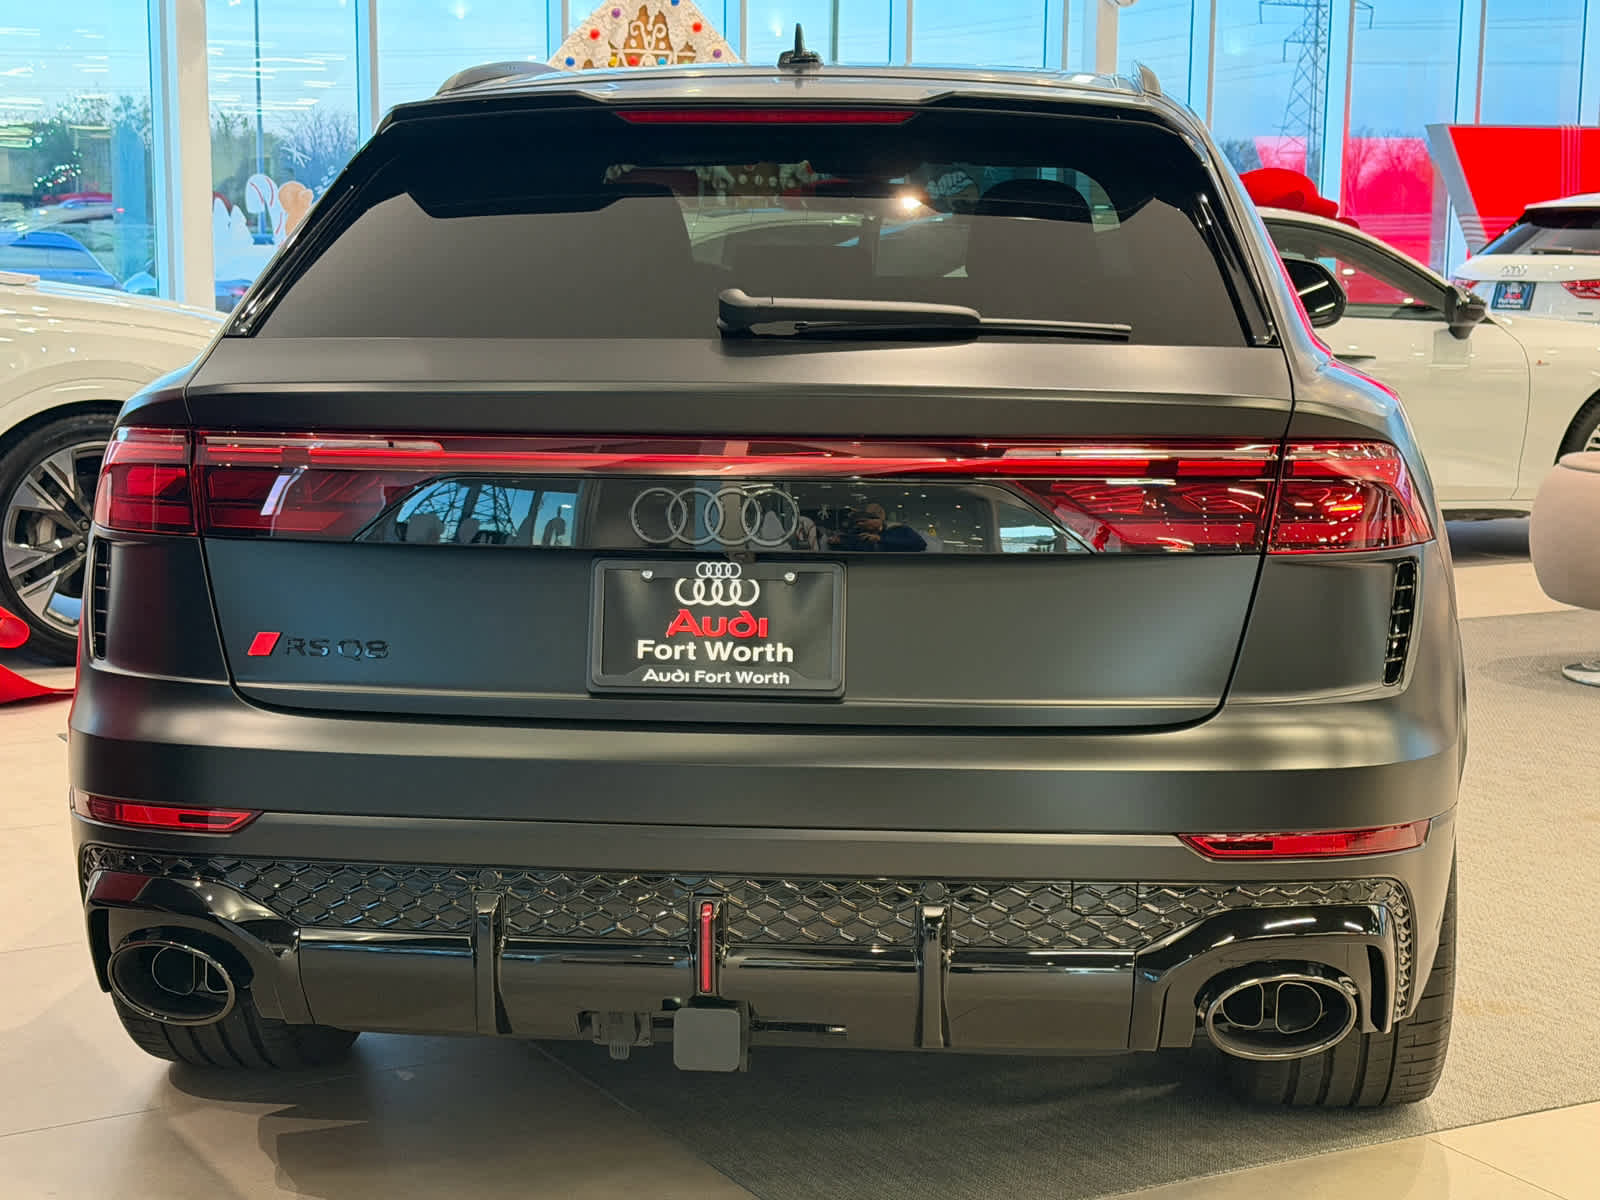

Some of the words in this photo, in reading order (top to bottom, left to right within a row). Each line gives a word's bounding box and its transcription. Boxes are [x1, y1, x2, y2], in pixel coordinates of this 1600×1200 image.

[665, 608, 769, 638] Audi
[286, 638, 330, 657] RS
[336, 639, 389, 661] Q8
[636, 640, 697, 661] Fort
[704, 641, 794, 663] Worth
[642, 669, 690, 683] Audi
[695, 670, 731, 684] Fort
[736, 671, 790, 685] Worth
